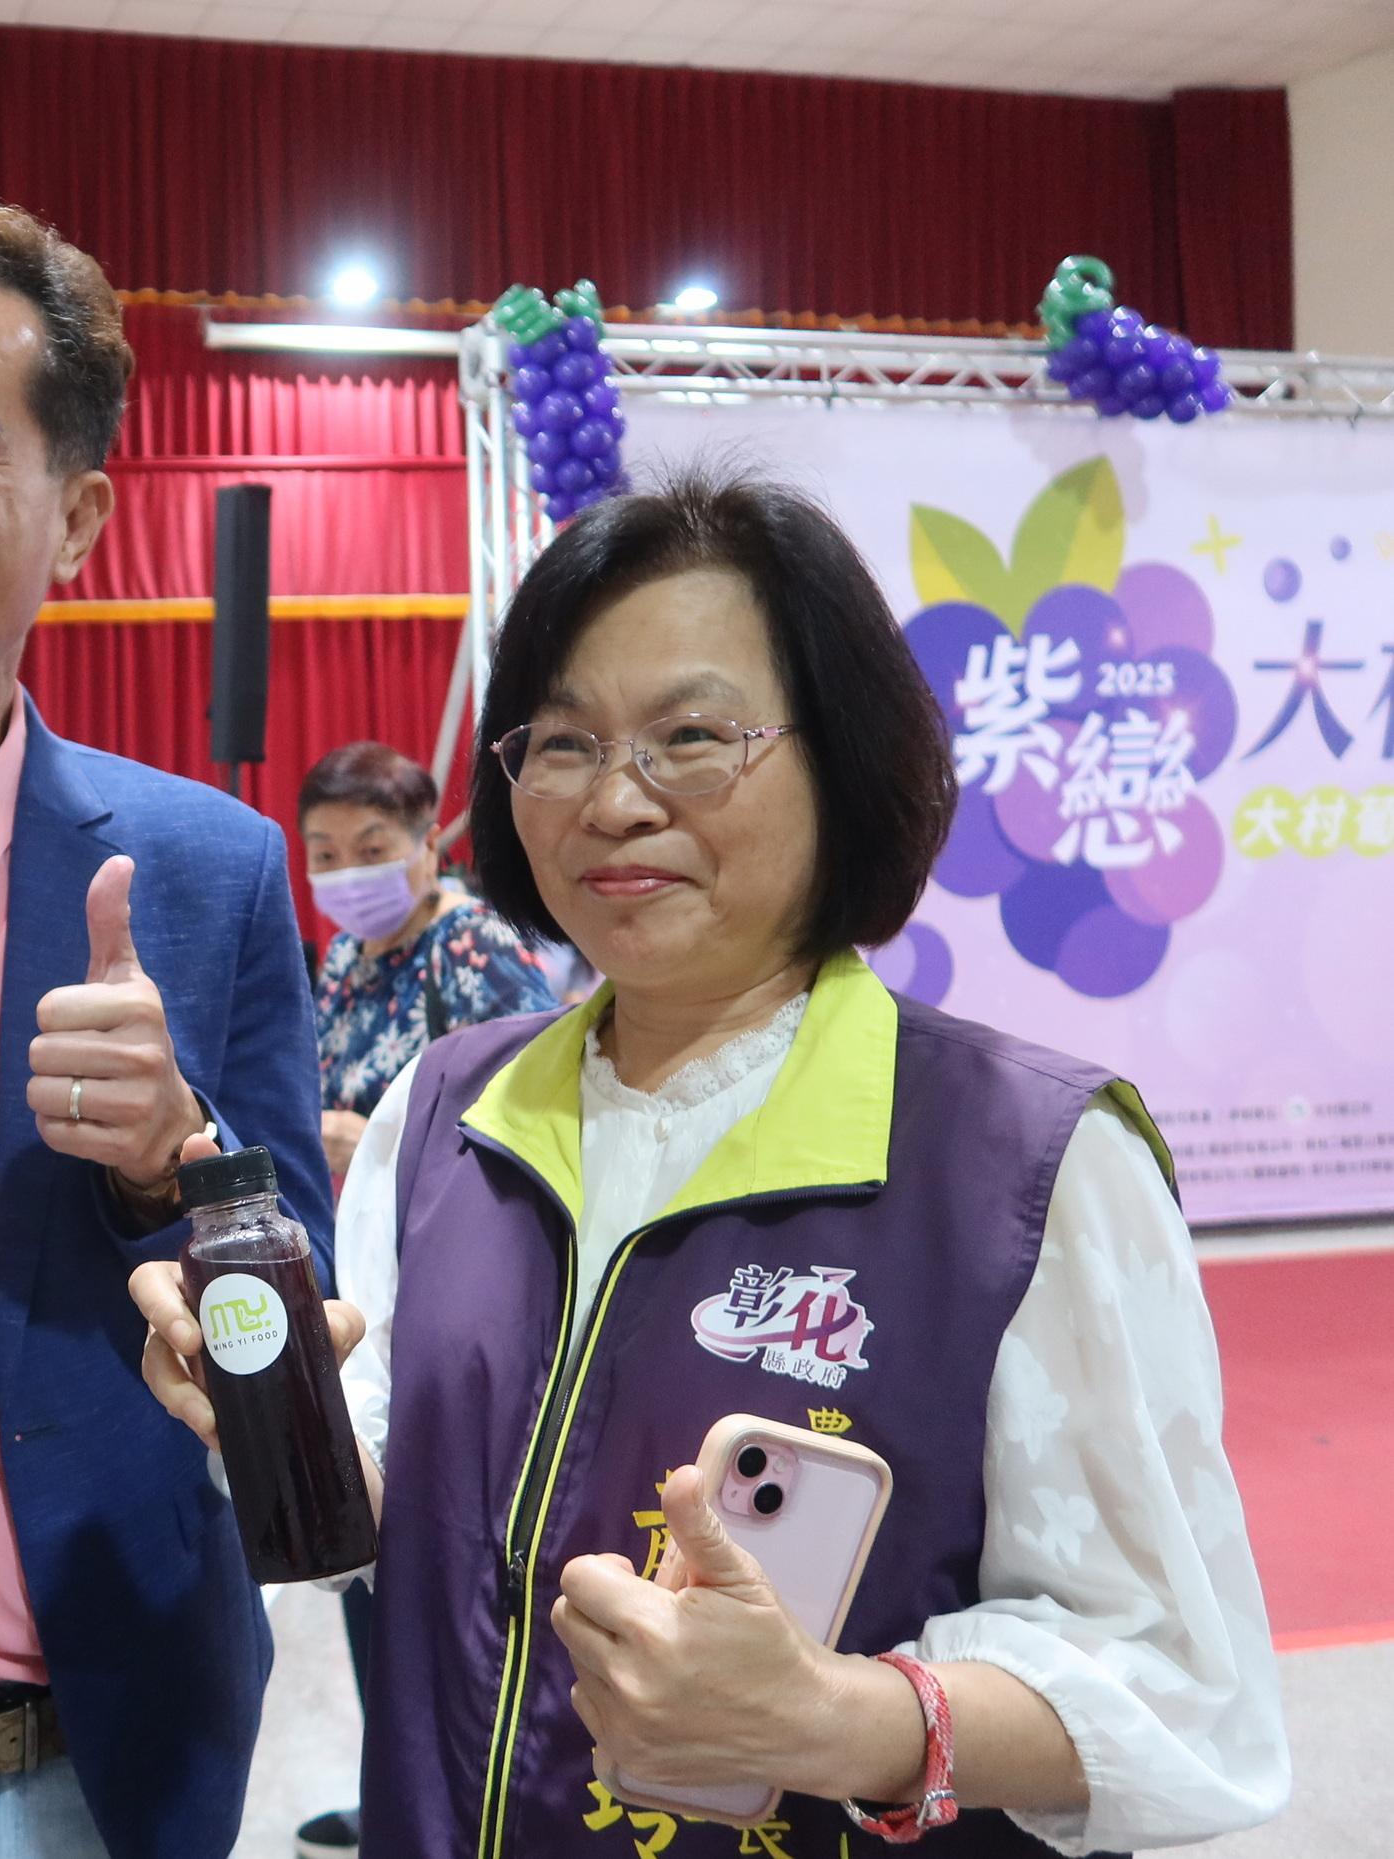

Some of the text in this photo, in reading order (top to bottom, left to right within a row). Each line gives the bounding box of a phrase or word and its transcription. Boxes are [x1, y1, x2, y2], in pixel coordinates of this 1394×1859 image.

[1096, 662, 1176, 696] 2025
[1238, 619, 1394, 763] 大
[723, 1265, 858, 1362] 彰化
[213, 1330, 278, 1351] MING YI FOOD
[763, 1350, 847, 1388] 縣政府
